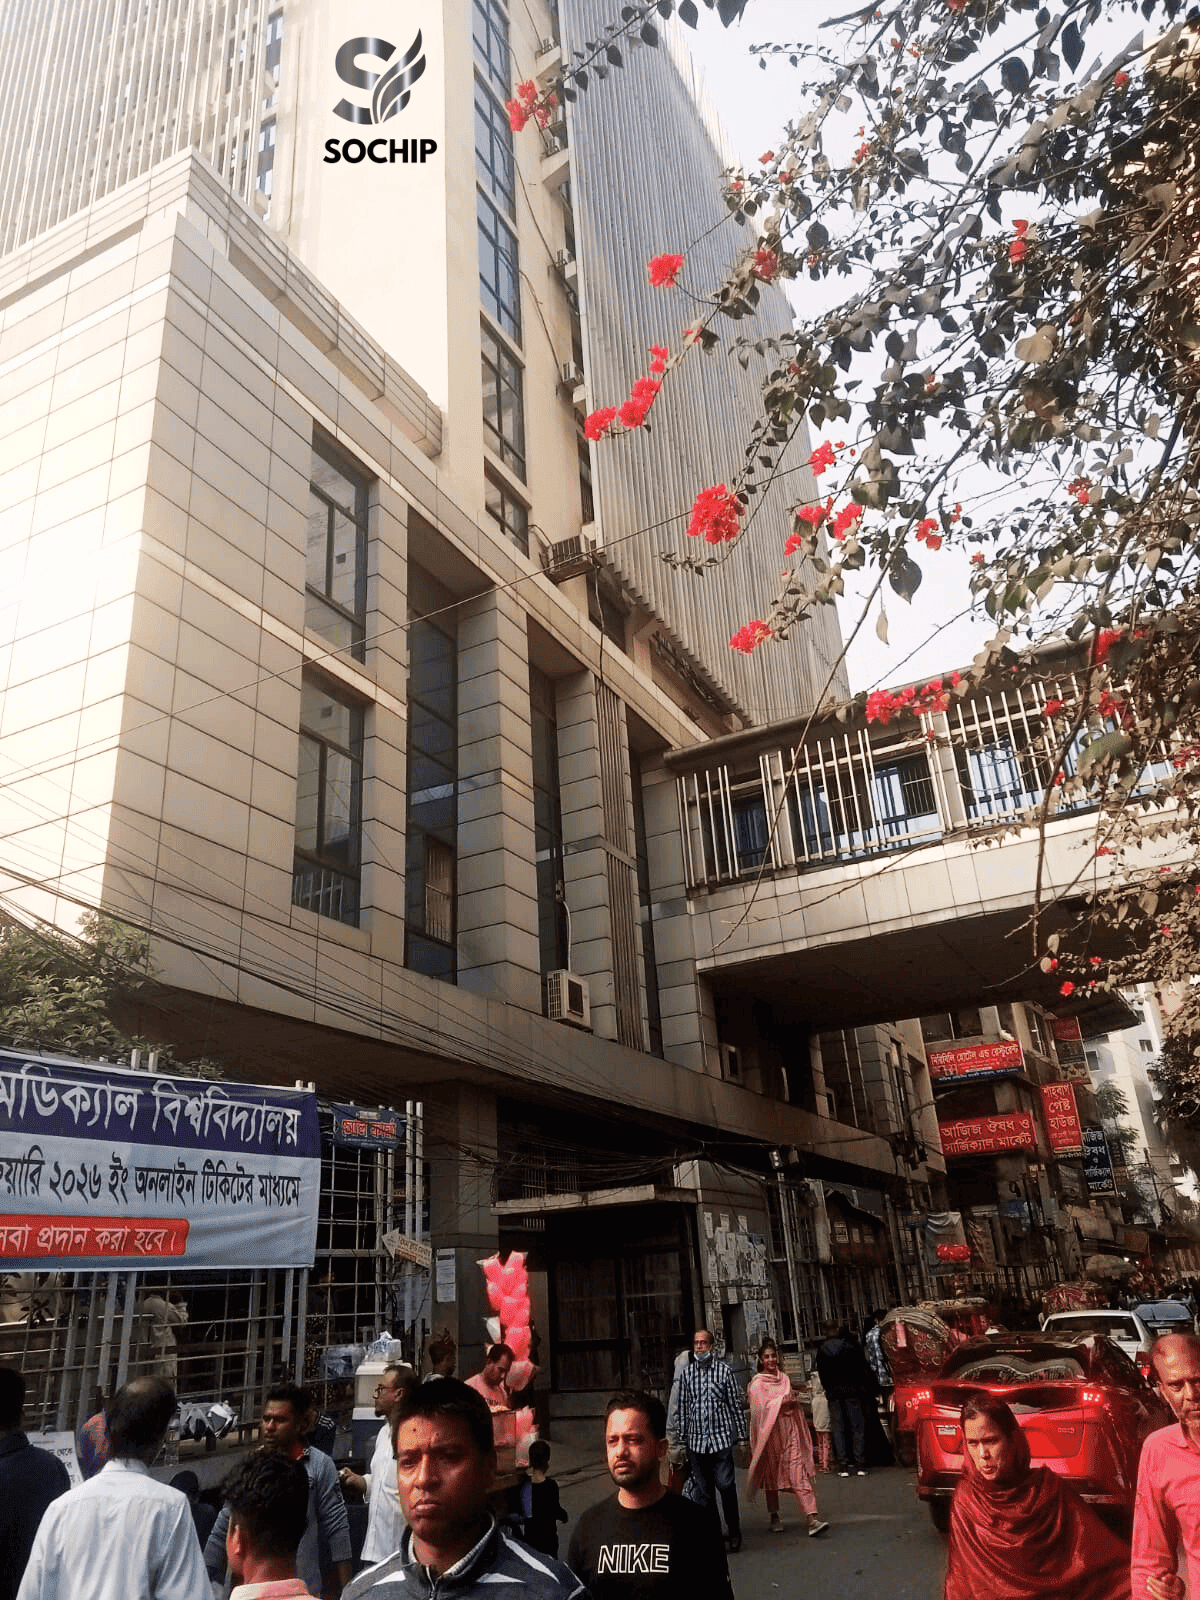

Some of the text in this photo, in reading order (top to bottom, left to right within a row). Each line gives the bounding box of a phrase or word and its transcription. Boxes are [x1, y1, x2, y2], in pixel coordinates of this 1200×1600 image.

[151, 1080, 301, 1147] বিশ্ববিদ্যালয়
[941, 1118, 1030, 1138] আজিজ ঔষধ ও
[0, 1144, 301, 1207] য়ারি ২০২৬ ইং অনলাইন টিকিটের মাধ্যমে
[37, 1225, 91, 1252] প্রদান
[94, 1226, 131, 1252] করা
[598, 1544, 669, 1573] NIKE
